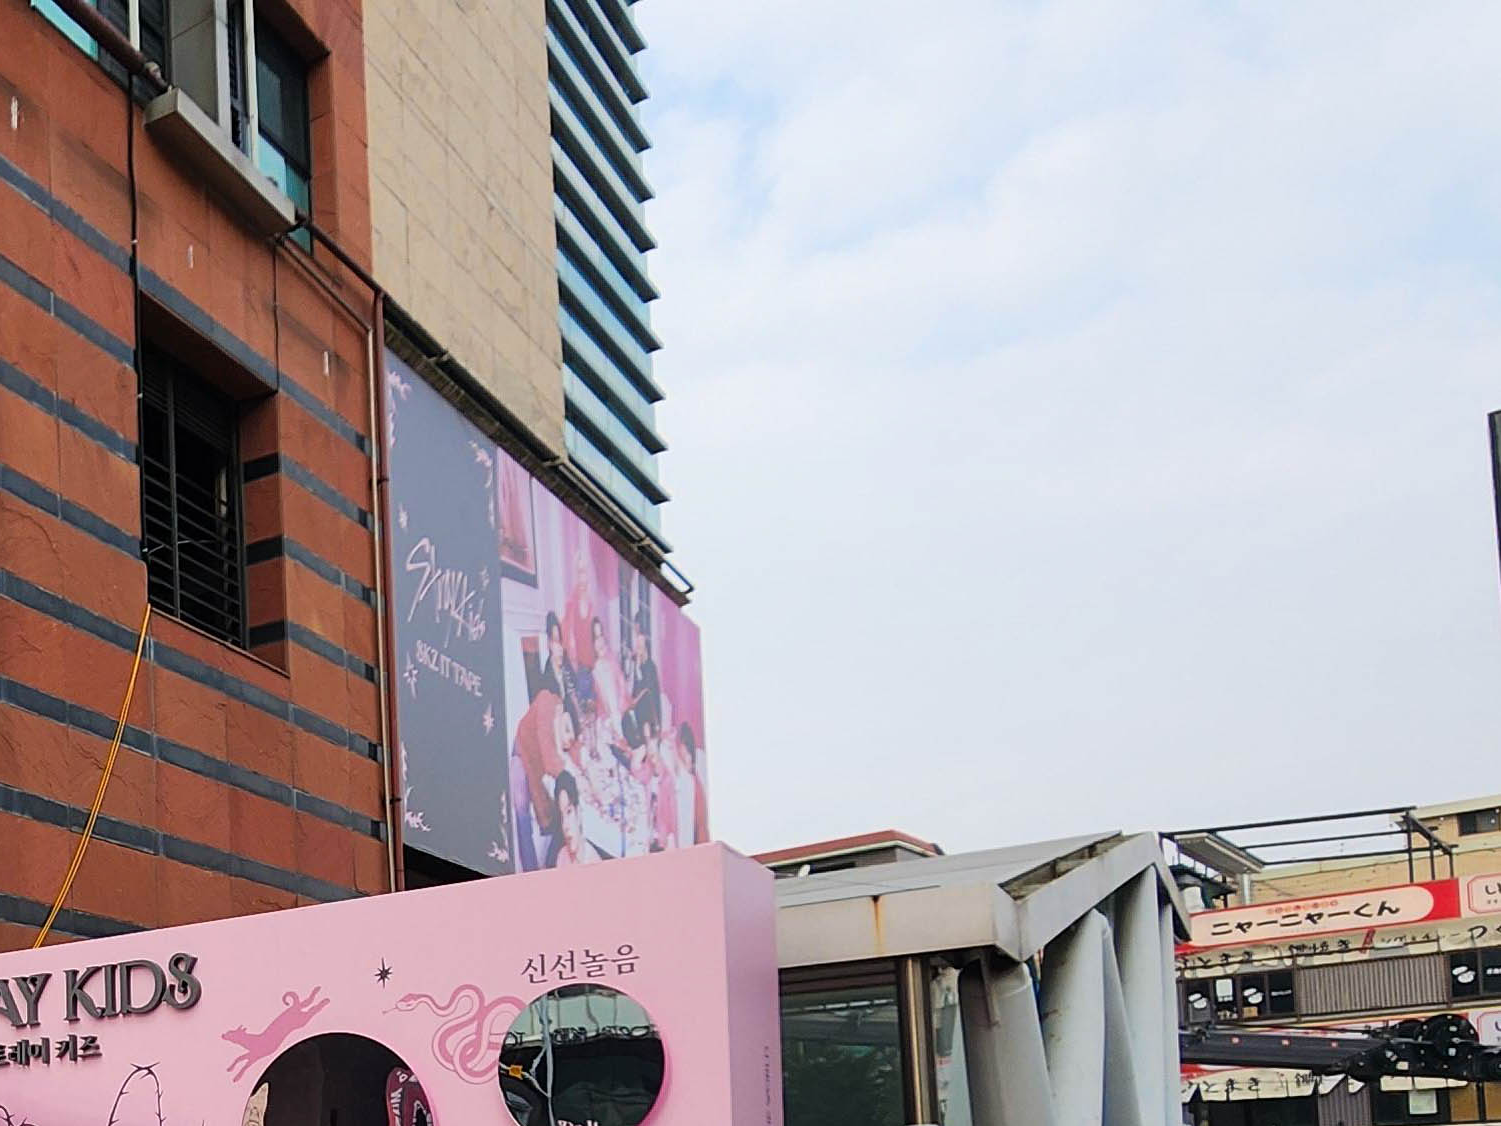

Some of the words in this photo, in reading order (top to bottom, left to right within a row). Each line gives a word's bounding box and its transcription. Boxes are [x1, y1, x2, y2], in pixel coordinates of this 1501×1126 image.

[1211, 900, 1400, 936] ニャーニャーくん
[521, 944, 640, 984] 신선놀음
[64, 952, 201, 1022] KIDS
[55, 1033, 103, 1061] 키즈
